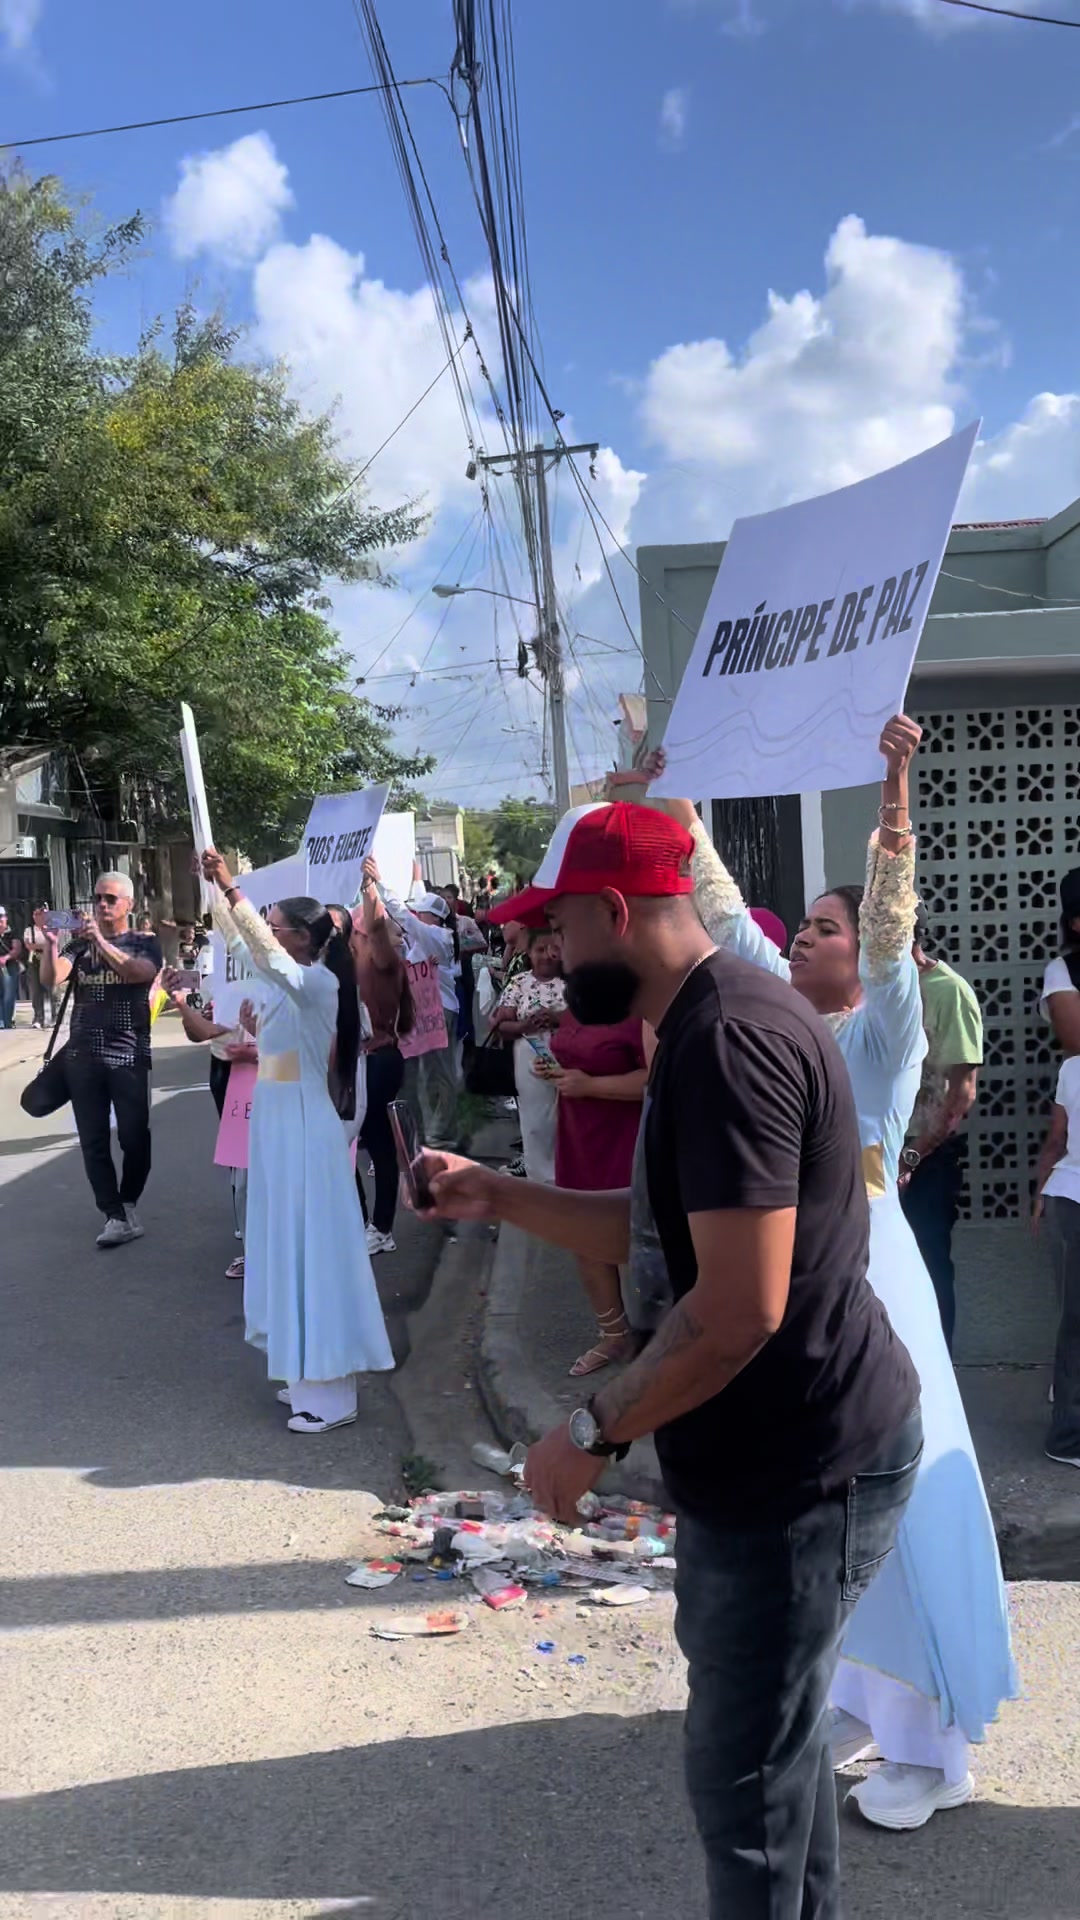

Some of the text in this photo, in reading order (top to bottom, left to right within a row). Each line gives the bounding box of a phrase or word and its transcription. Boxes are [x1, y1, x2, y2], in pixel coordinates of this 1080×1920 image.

[702, 560, 930, 677] PRÍNCIPE DE PAZ
[331, 826, 372, 863] FUERTE
[78, 970, 104, 984] Red
